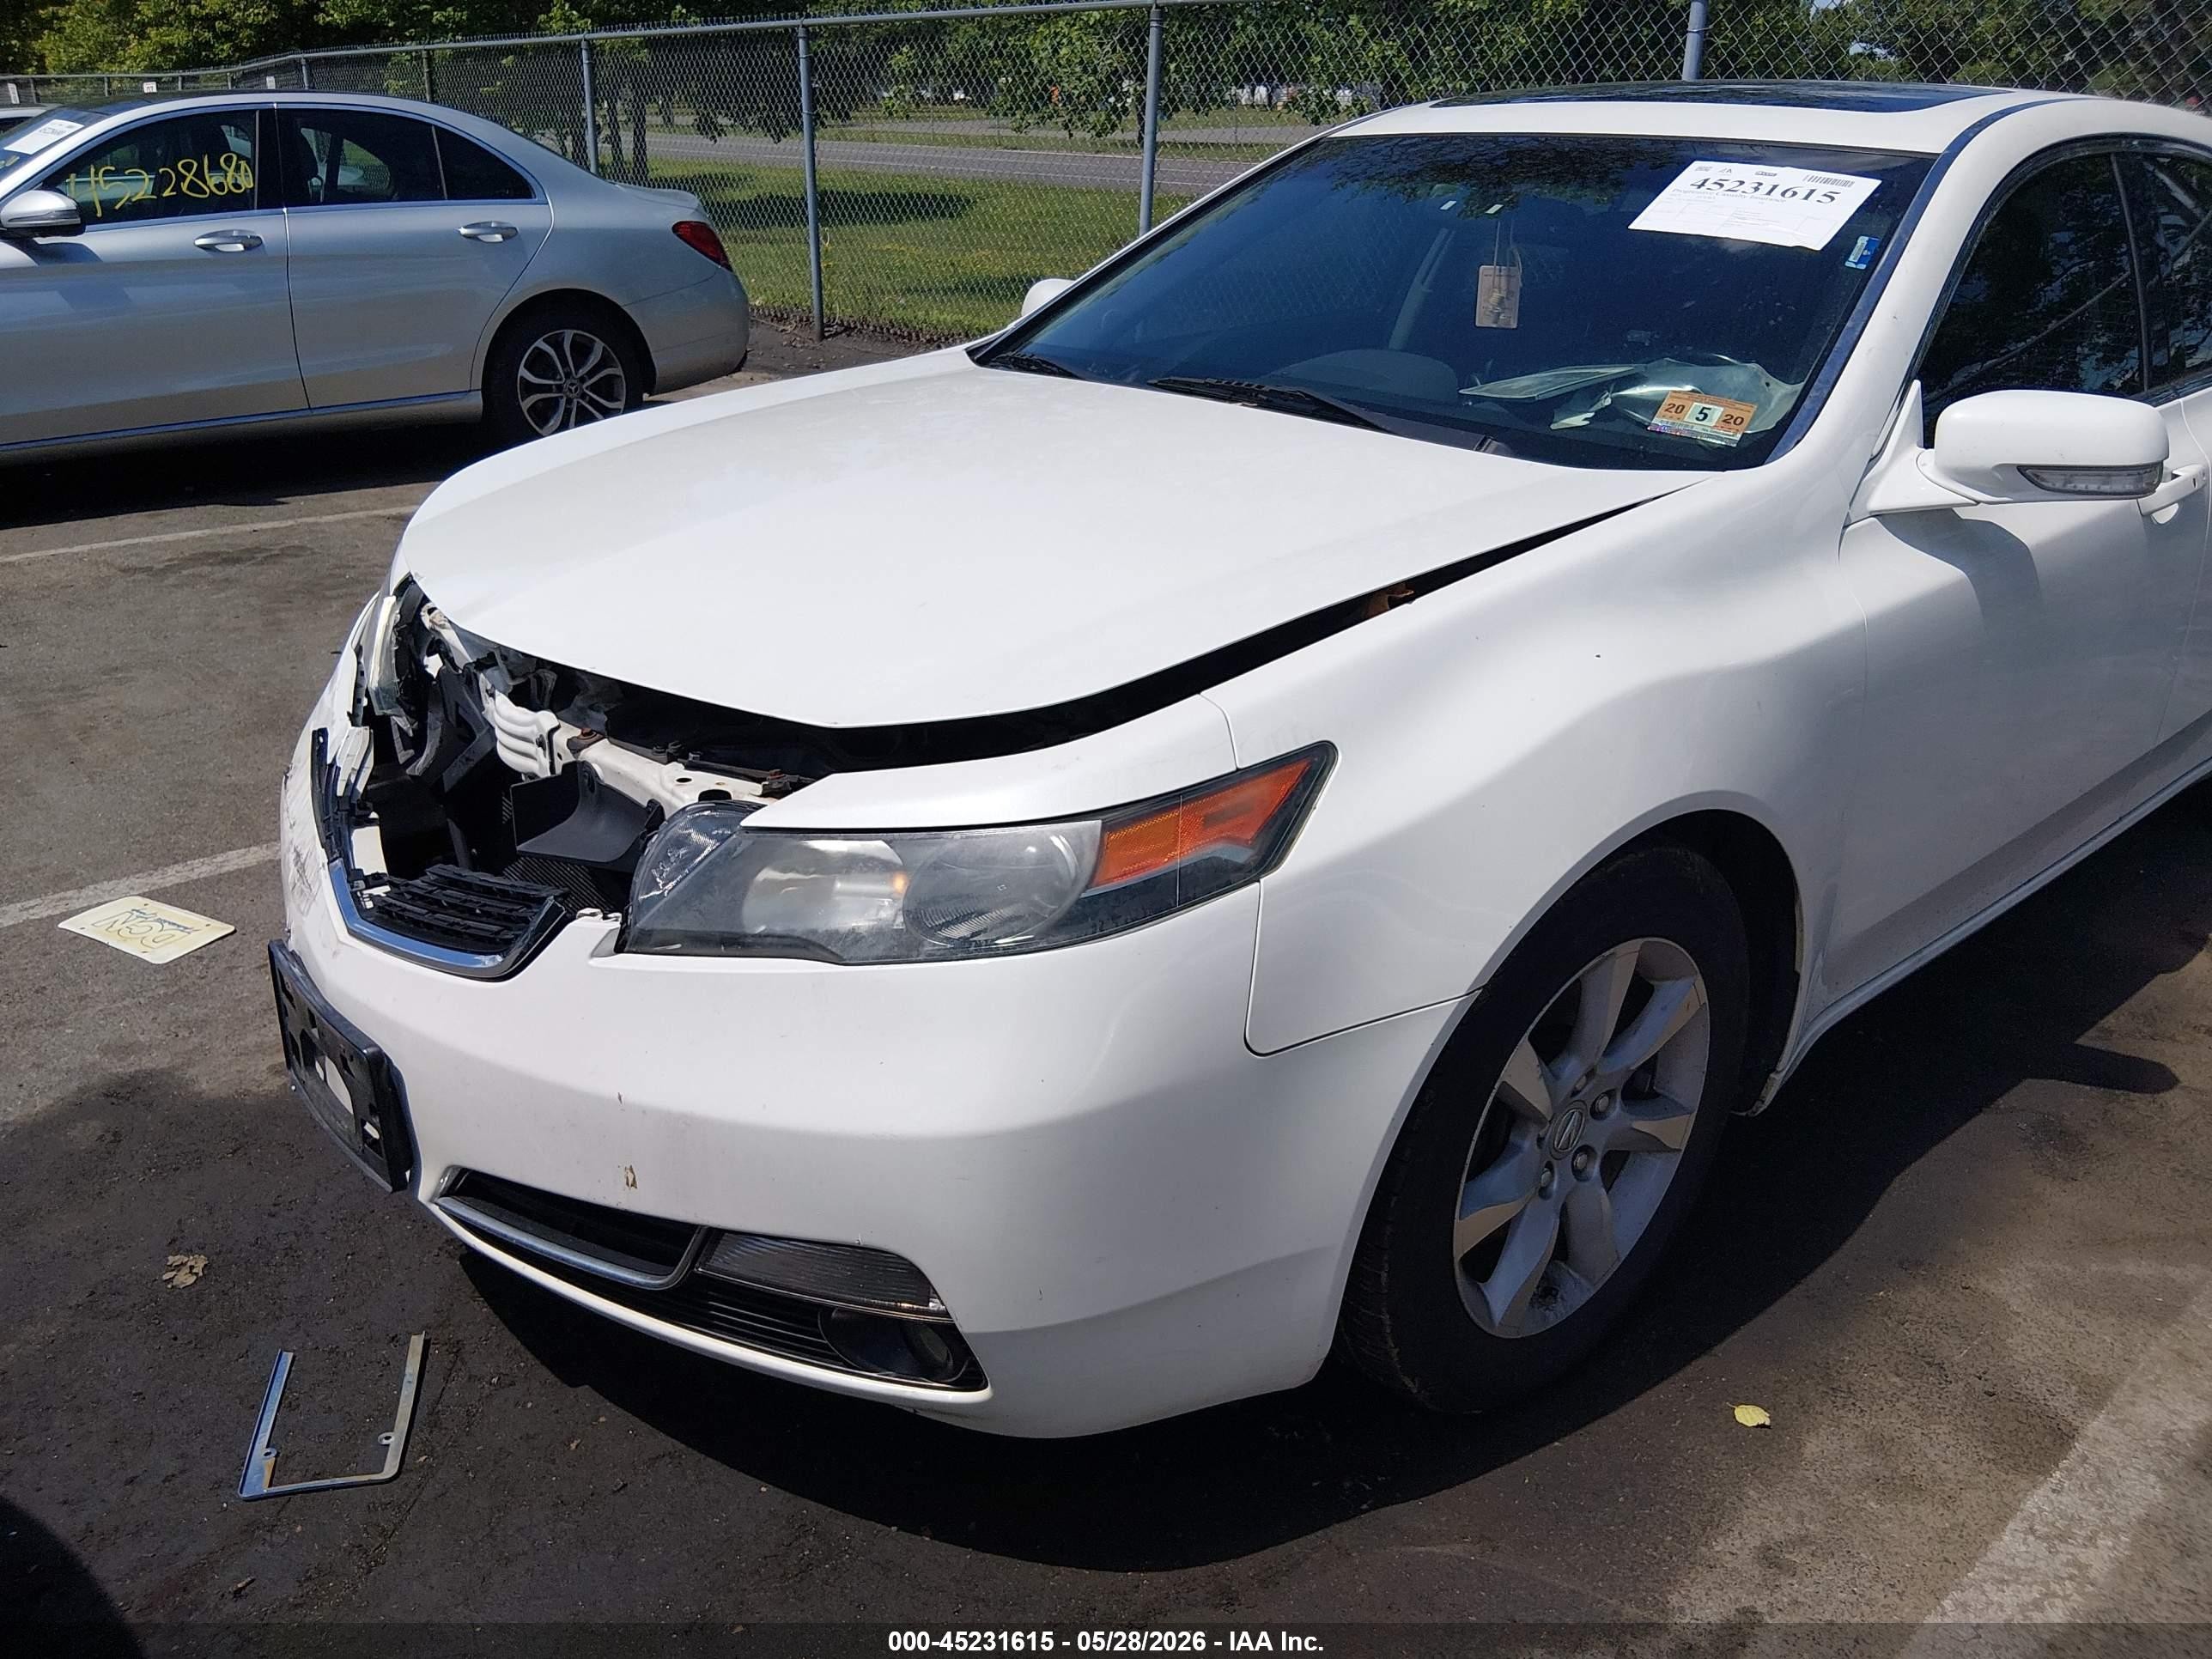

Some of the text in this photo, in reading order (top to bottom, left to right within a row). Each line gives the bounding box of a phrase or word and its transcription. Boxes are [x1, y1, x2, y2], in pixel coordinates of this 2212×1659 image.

[70, 153, 253, 217] 45228680
[1690, 177, 1841, 204] 45231615
[1665, 403, 1744, 426] 20 5 20
